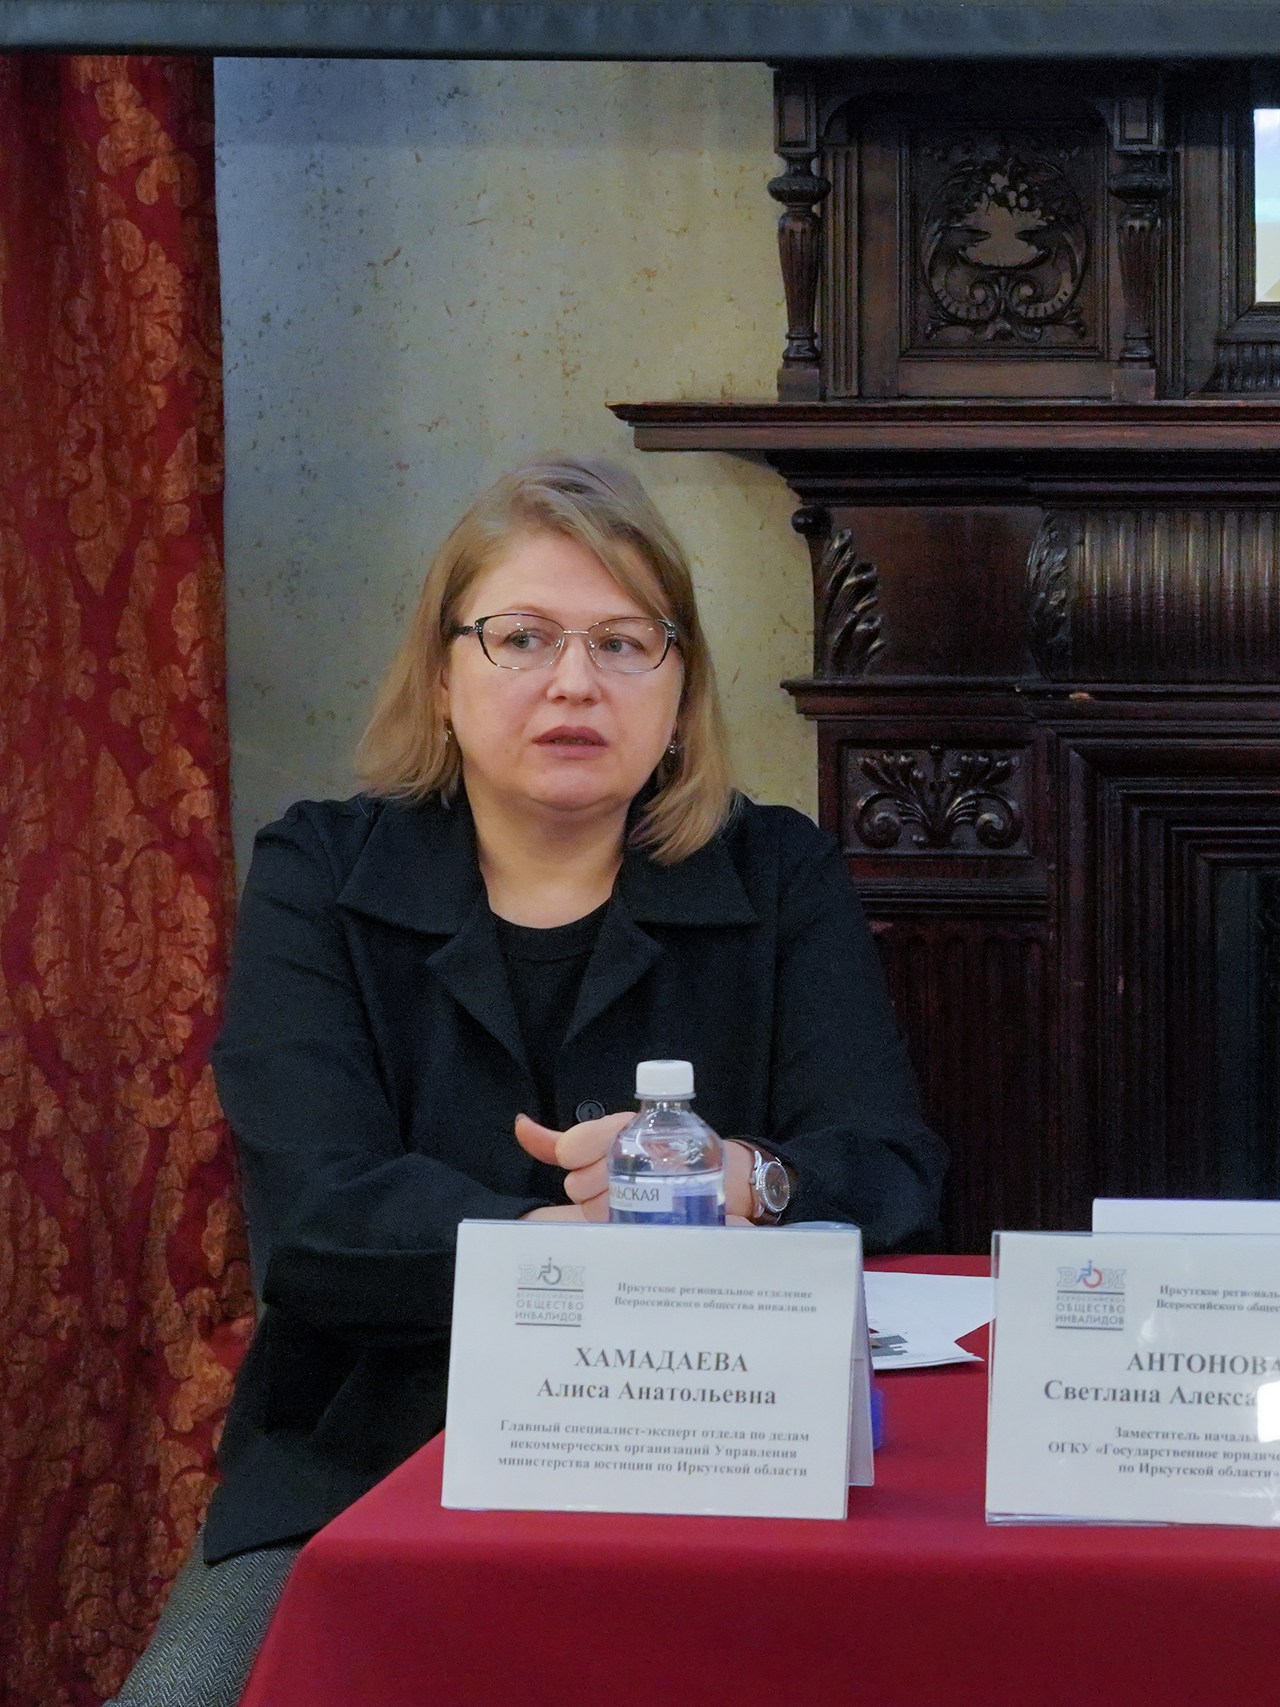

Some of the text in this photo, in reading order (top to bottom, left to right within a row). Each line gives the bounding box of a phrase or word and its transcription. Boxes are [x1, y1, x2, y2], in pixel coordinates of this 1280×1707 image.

[616, 1187, 659, 1201] ЬСКАЯ
[618, 1282, 813, 1299] Иркутское региональное отделение
[1160, 1284, 1219, 1298] Иркутское
[516, 1300, 584, 1311] ОБЩЕСТВО
[615, 1296, 817, 1313] Всероссийского общества инвалидов
[1056, 1303, 1125, 1313] ОБЩЕСТВО
[1156, 1299, 1244, 1313] Всероссийского
[515, 1311, 583, 1323] ИНВАЛИДОВ
[1055, 1314, 1124, 1325] ИНВАЛИДОВ
[575, 1347, 748, 1372] ХАМАДАЕВА
[537, 1378, 776, 1404] Алиса Анатольевна
[1044, 1380, 1160, 1404] Светлана
[501, 1420, 809, 1441] Главный специалист-эксперт отдела по делам
[1115, 1427, 1199, 1441] Заместитель
[510, 1439, 797, 1458] некоммерческих организаций Управления
[1049, 1442, 1089, 1454] ОГКУ
[1095, 1443, 1218, 1461] «Государственное
[499, 1458, 807, 1477] министерства юстиции по Иркутской области
[1119, 1465, 1134, 1474] по
[1139, 1462, 1213, 1478] Иркутской
